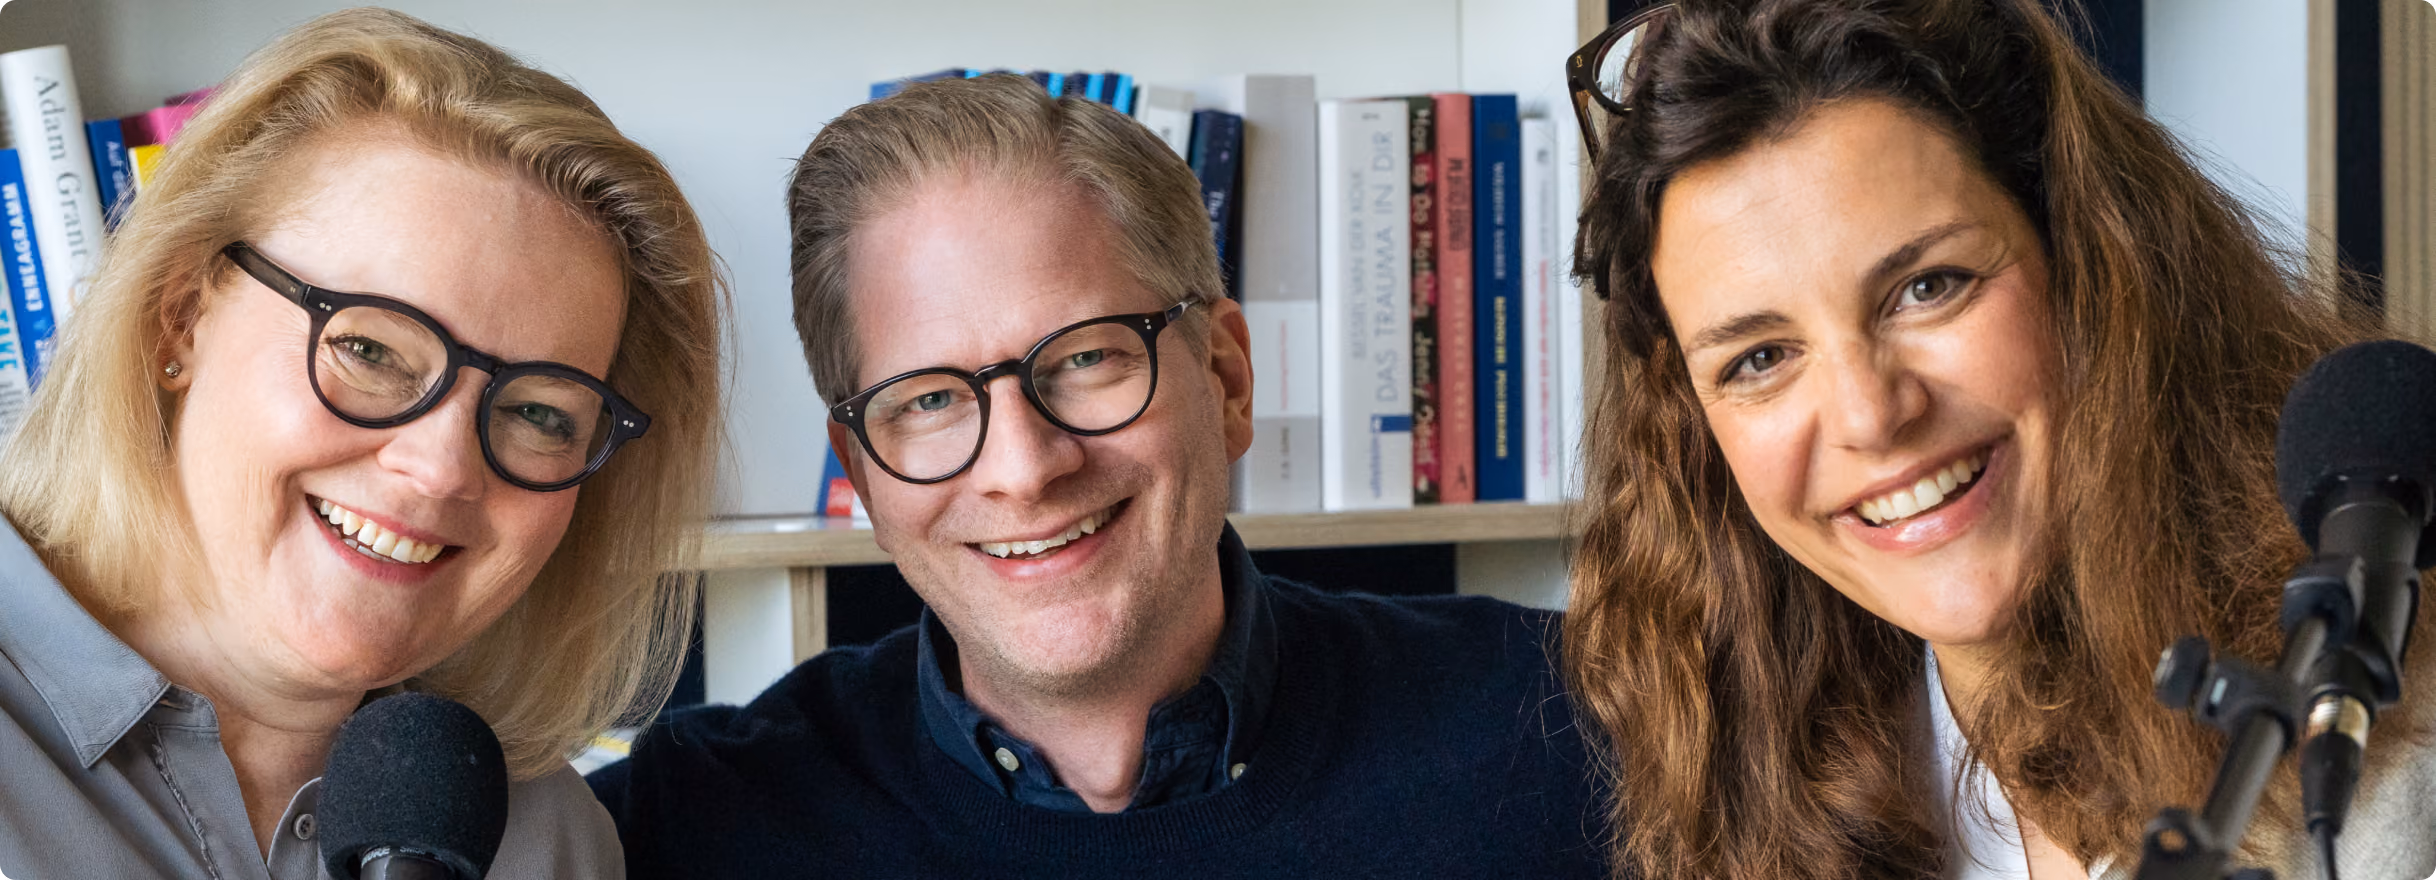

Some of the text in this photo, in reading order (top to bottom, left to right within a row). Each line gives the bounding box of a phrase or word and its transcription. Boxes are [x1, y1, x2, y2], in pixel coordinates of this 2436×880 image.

[34, 75, 88, 259] Adam Grant
[1371, 130, 1395, 172] DIR
[1373, 184, 1396, 214] IN
[1412, 192, 1432, 225] Do
[2, 182, 43, 312] ENNEAGRAMM
[1374, 226, 1397, 336] TRAUMA
[1375, 348, 1399, 402] DAS
